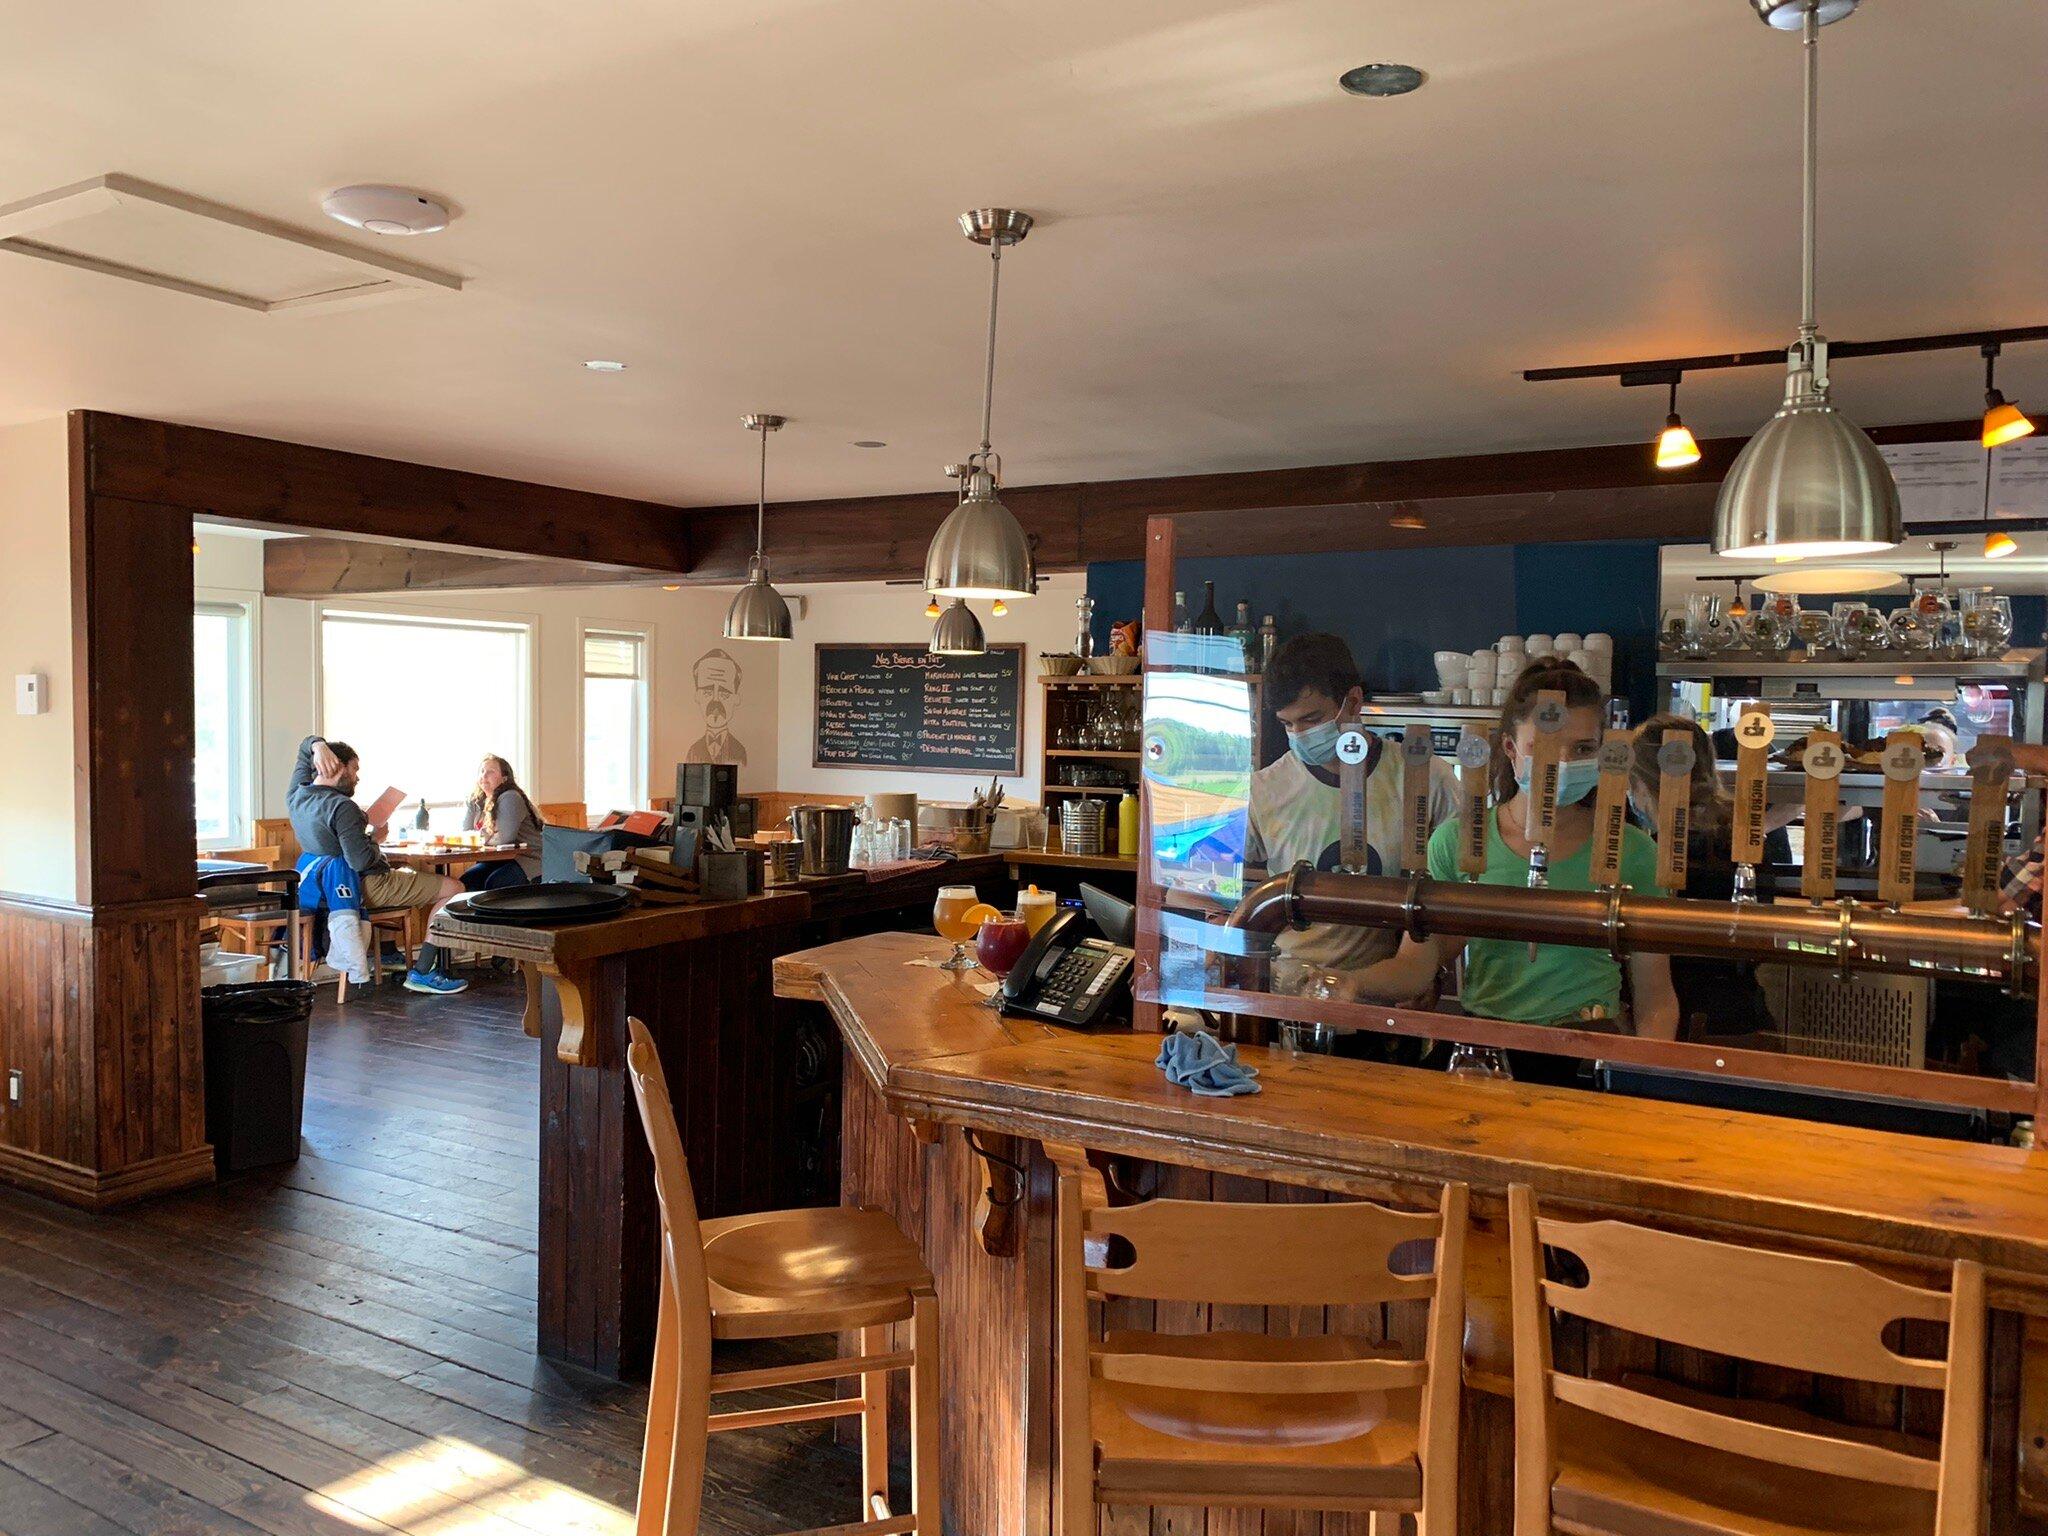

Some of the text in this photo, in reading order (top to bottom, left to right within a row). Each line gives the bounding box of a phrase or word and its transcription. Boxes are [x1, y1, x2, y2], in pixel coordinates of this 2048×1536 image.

[1415, 796, 1426, 856] MICRO DU LAC
[1473, 796, 1483, 825] MICRO
[1542, 764, 1556, 827] MICRO DU LAC
[1749, 780, 1763, 846] MICRO DU LAC
[1606, 805, 1621, 870] MICRO DU LAC
[1672, 808, 1685, 873] MICRO DU LAC
[1820, 813, 1834, 880] MICRO DU LAC
[1899, 815, 1914, 884] MICRO DU LAC
